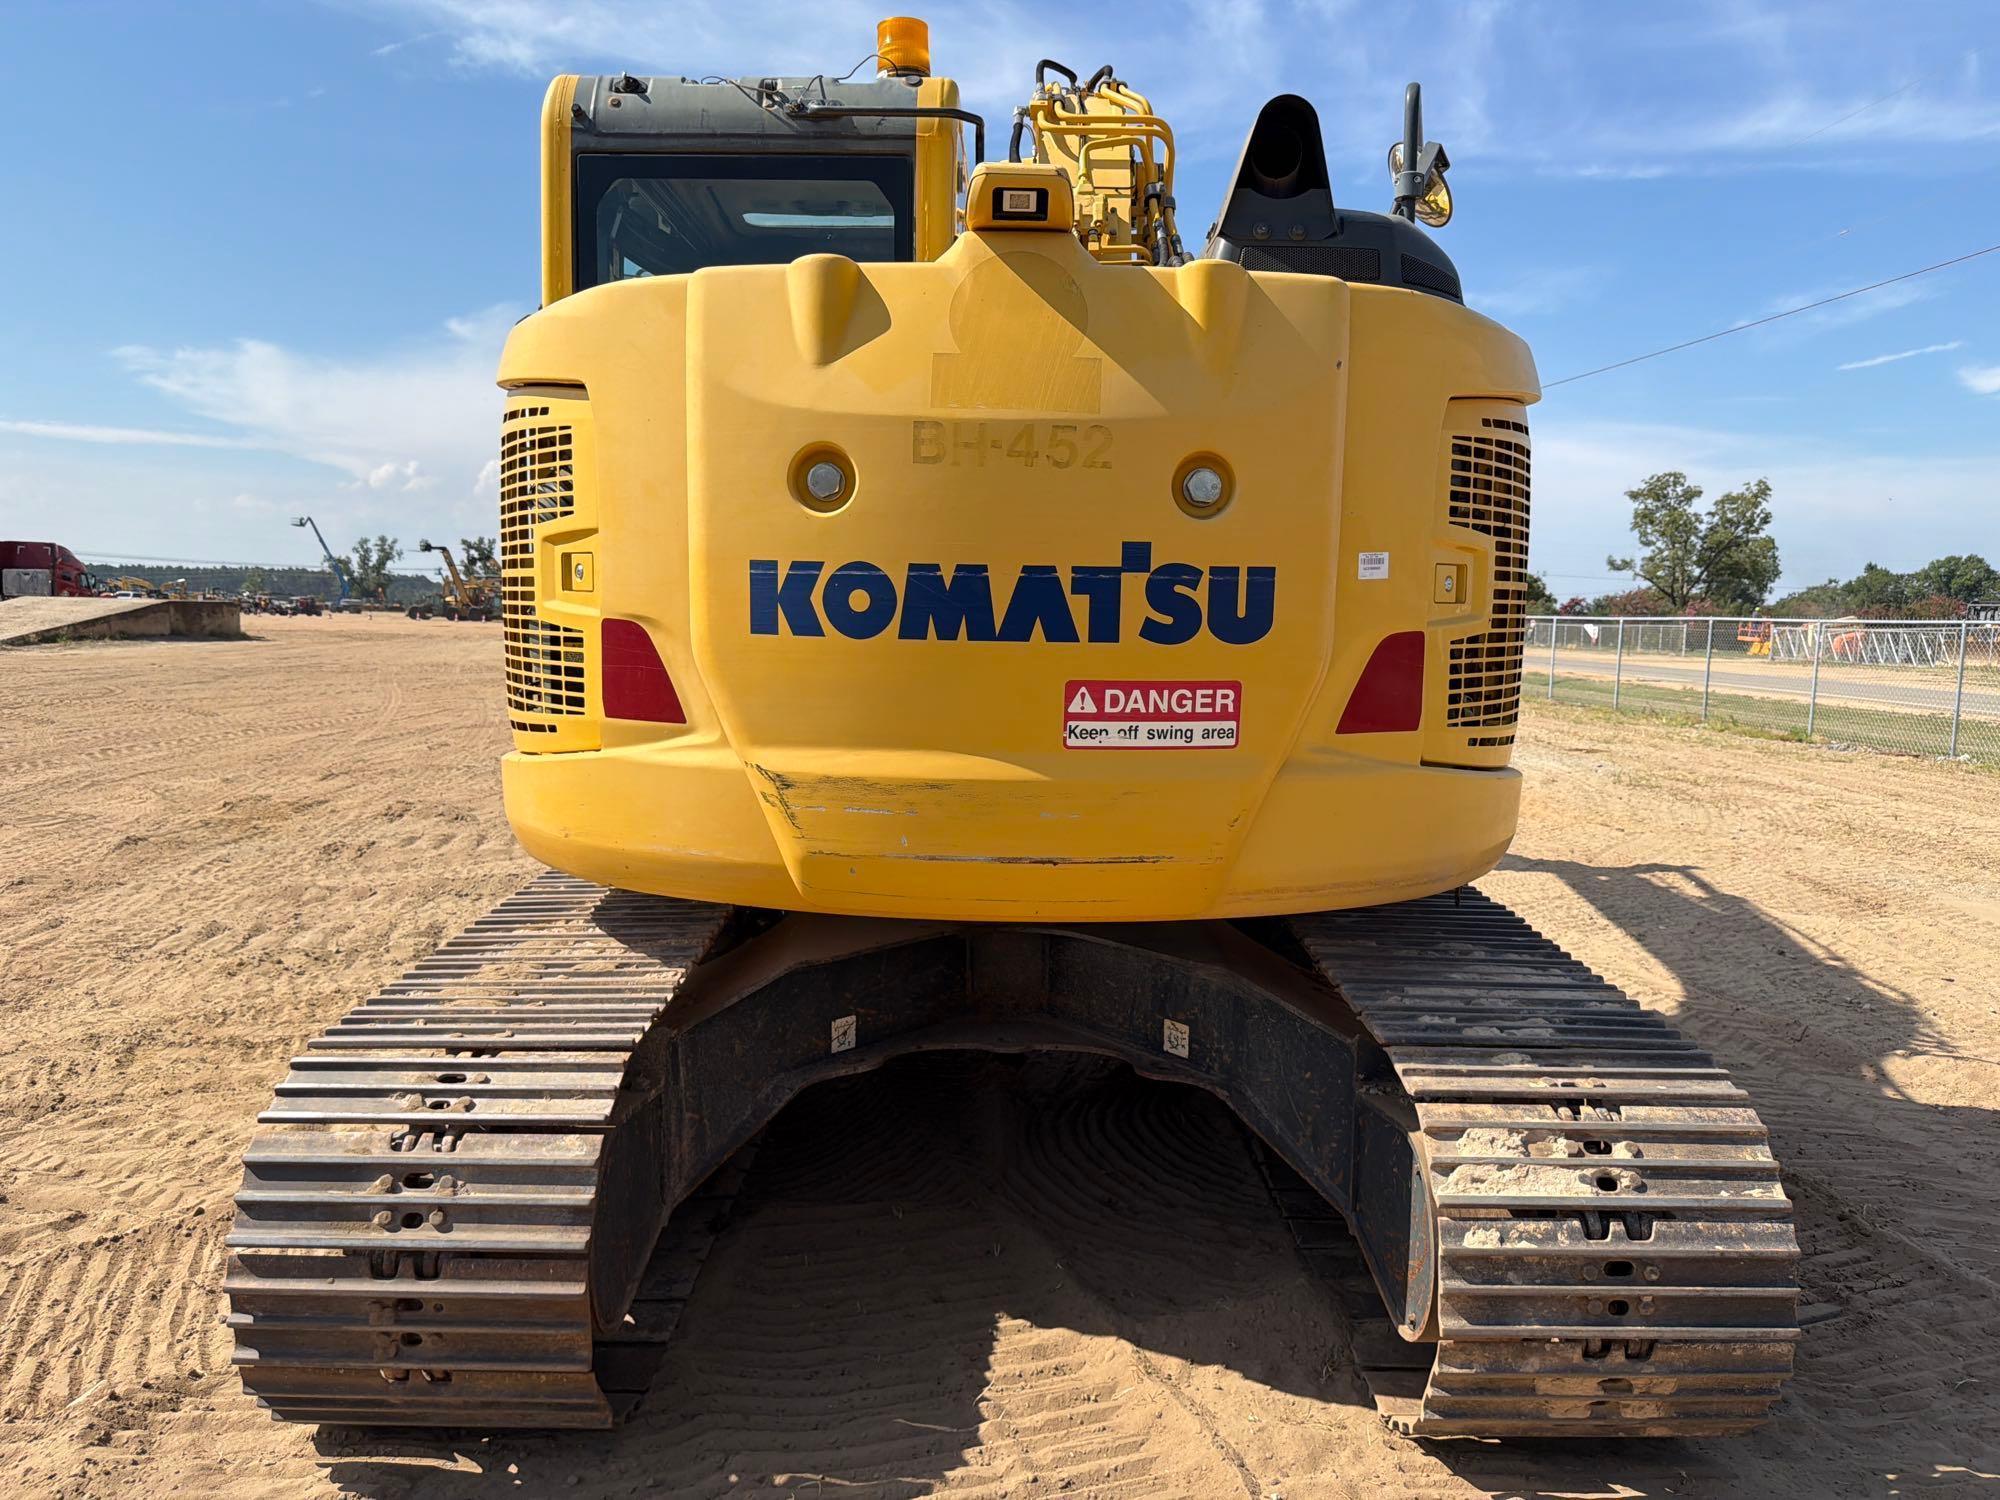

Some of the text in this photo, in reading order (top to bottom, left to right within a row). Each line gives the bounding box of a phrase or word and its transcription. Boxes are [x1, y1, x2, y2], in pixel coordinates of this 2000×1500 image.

[912, 420, 1113, 469] BH-452
[749, 541, 1276, 645] KOMATSU
[1104, 689, 1235, 713] DANGER
[1068, 724, 1235, 743] Keep off swing area
